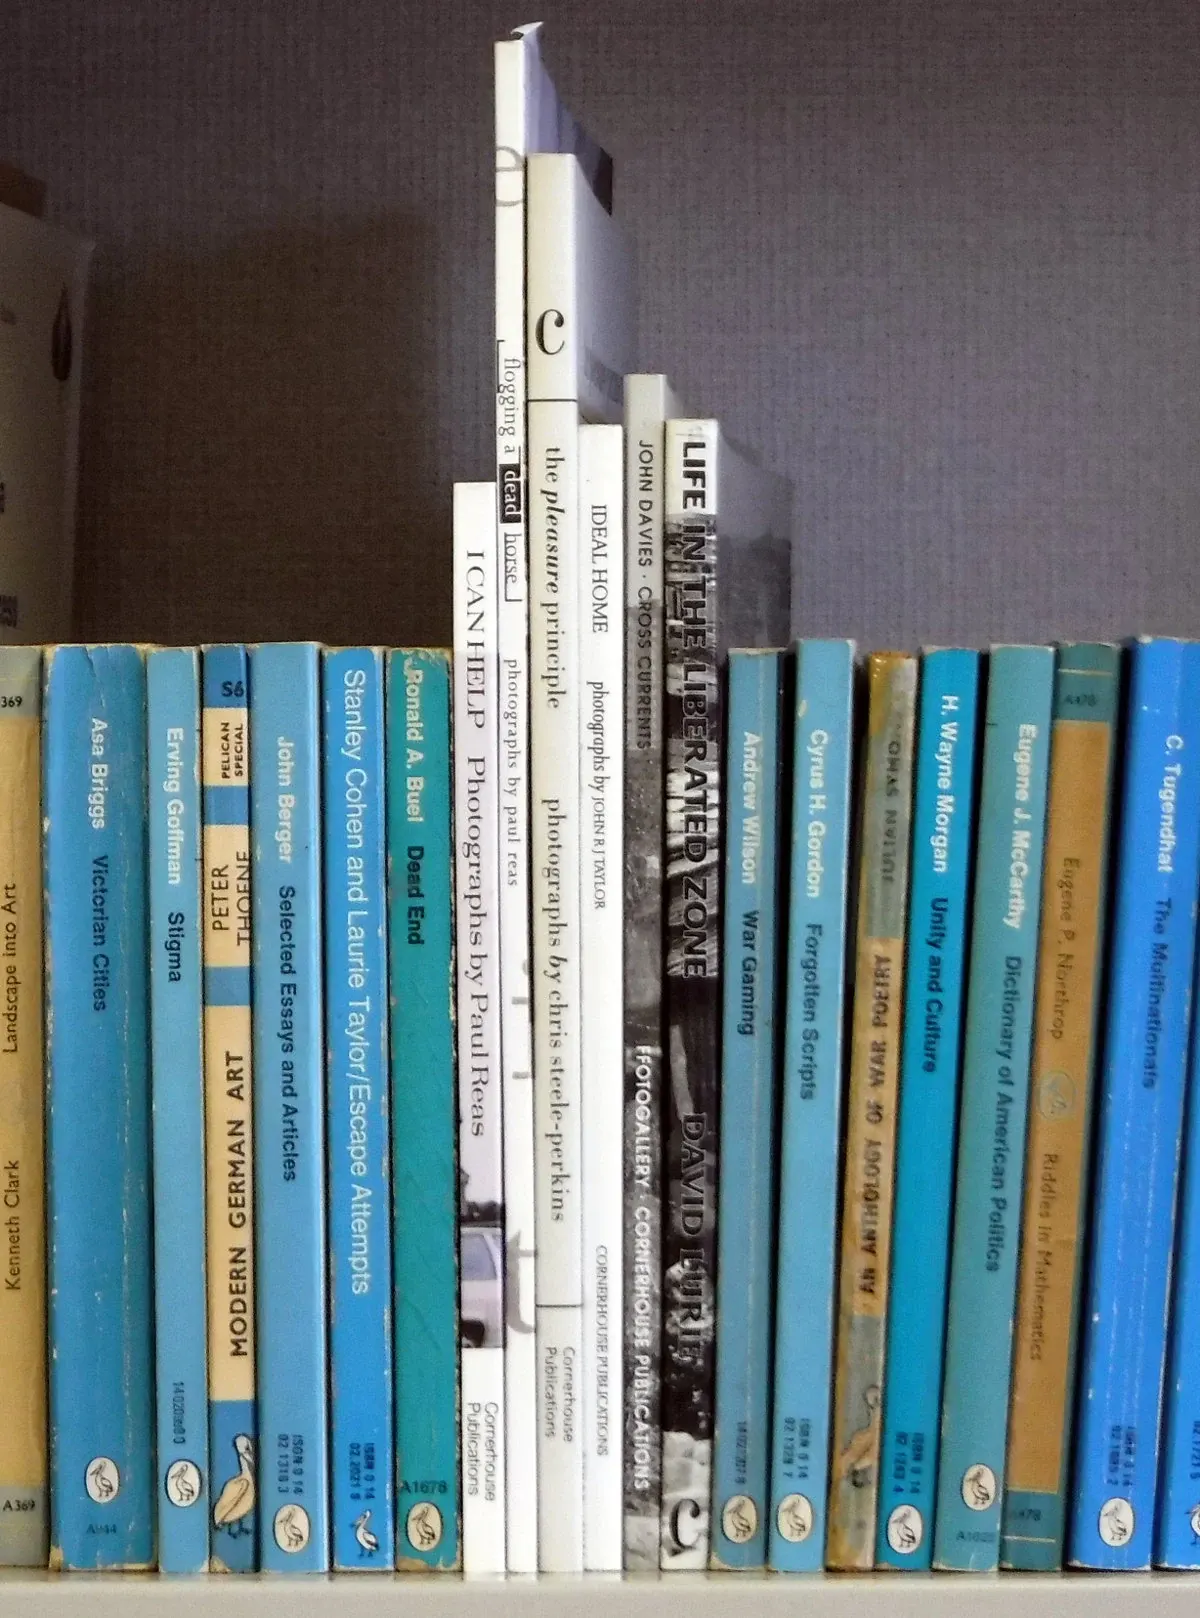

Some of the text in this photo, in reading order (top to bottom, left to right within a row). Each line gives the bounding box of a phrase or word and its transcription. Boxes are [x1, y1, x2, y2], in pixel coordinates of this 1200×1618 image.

[499, 357, 522, 584] flogging a dead horse
[541, 447, 567, 709] the pleasure principle
[591, 504, 609, 633] IDEAL HOME
[637, 440, 654, 749] JOHN DAVIES CROSS CURRENTS
[1, 696, 23, 708] 369
[221, 681, 245, 697] S6
[467, 551, 485, 729] I CAN HELP
[163, 727, 184, 793] Erving
[220, 722, 231, 779] PELICAN
[233, 723, 244, 777] SPECIAL
[503, 659, 522, 887] photographs by paul reas
[588, 681, 611, 771] photographs
[682, 441, 708, 978] LIFE IN THE LIBERATED ZONE
[405, 669, 425, 946] Ronald A. Buel Dead End
[589, 776, 611, 793] by
[593, 796, 606, 835] JOHN
[594, 838, 606, 847] R
[882, 808, 898, 882] JULIAN
[88, 717, 110, 1012] Asa Briggs Victorian Cities
[211, 864, 230, 931] PETER
[594, 858, 606, 910] TAYLOR
[738, 731, 762, 1036] Andrew Wilson War Gaming
[798, 729, 829, 1101] Cyrus H. Gordon Forgotten Scripts
[922, 695, 959, 1074] H. Wayne Morgan Unity and Culture
[1058, 857, 1082, 922] Eugene
[1142, 735, 1184, 1090] C. Tugendhat The Multinationals
[1, 883, 21, 1053] Landscape into Art
[164, 912, 185, 983] Stigma
[275, 736, 300, 1182] John Berger Selected Essays and Articles
[340, 668, 372, 1295] Stanley Cohen and Laurie Taylor/Escape Attempts
[463, 756, 489, 1137] Photographs by Paul Reas
[985, 724, 1038, 1272] Eugene J. McCarthy Dictionary of American Politics
[1046, 953, 1075, 1040] Northrop
[1058, 930, 1077, 944] P.
[542, 798, 571, 1223] photographs by chris steele-perkins
[679, 1112, 708, 1237] DAVID
[859, 954, 891, 1295] AN ANTHOLOGY OF WAR POETRY
[1037, 1154, 1060, 1219] Riddles
[4, 1160, 21, 1290] Kenneth Clark
[225, 1051, 248, 1357] MODERN GERMAN ART
[635, 1206, 651, 1348] CORNERHOUSE
[1028, 1250, 1054, 1362] Mathematics
[544, 1346, 561, 1438] Publications
[563, 1346, 577, 1443] Cornerhouse
[596, 1245, 609, 1456] CORNERHOUSE PUBLICATIONS
[467, 1402, 483, 1496] Publications
[484, 1402, 500, 1501] Cornerhouse
[634, 1355, 650, 1489] PUBLICATIONS
[3, 1499, 36, 1512] A369
